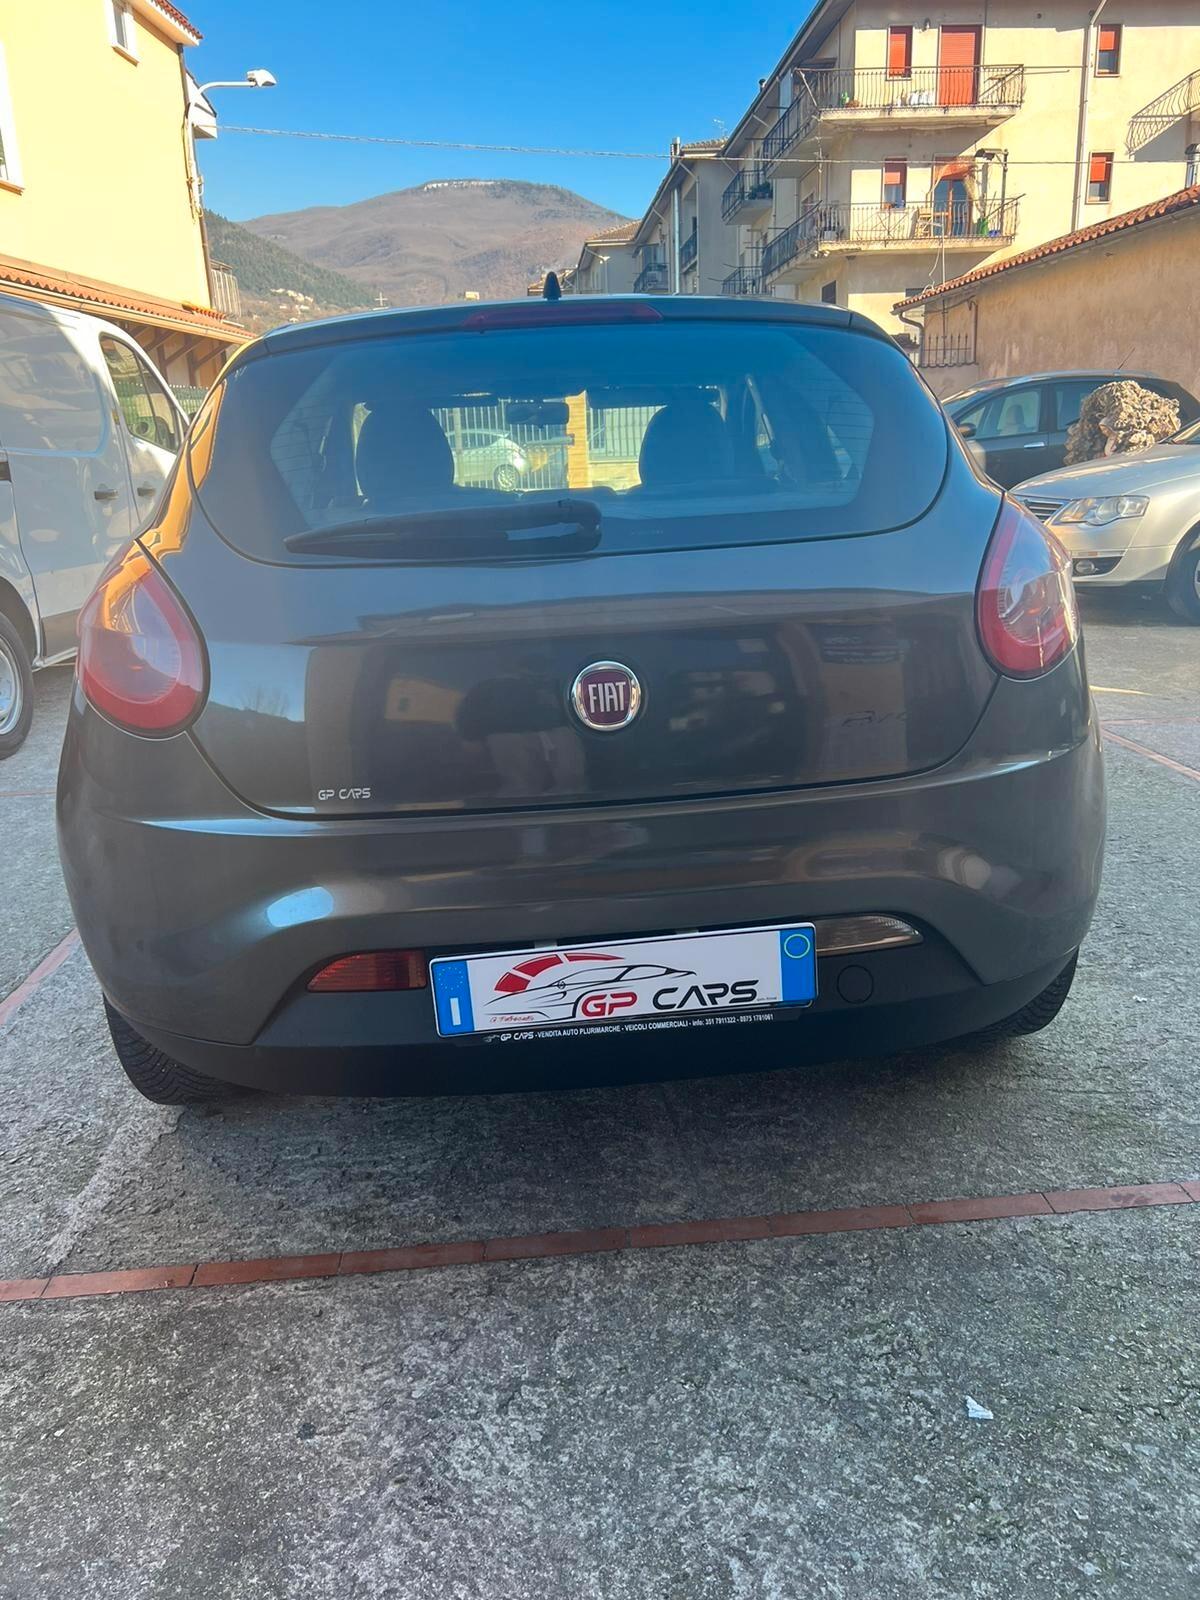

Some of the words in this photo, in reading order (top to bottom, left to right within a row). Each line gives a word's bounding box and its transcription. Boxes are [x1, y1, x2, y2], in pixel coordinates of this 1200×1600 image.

[588, 681, 626, 713] FIAT
[318, 789, 335, 800] GP
[339, 788, 371, 799] CARS
[581, 991, 638, 1017] GP
[652, 979, 759, 1011] CARS
[500, 1033, 512, 1042] GP
[513, 1031, 534, 1041] CARS
[538, 1030, 563, 1038] VENDITA
[563, 1028, 579, 1037] AUTO
[579, 1025, 621, 1036] PLURIMARCHE
[624, 1021, 648, 1032] VEICOLI
[648, 1020, 689, 1030] COMMERCIALI
